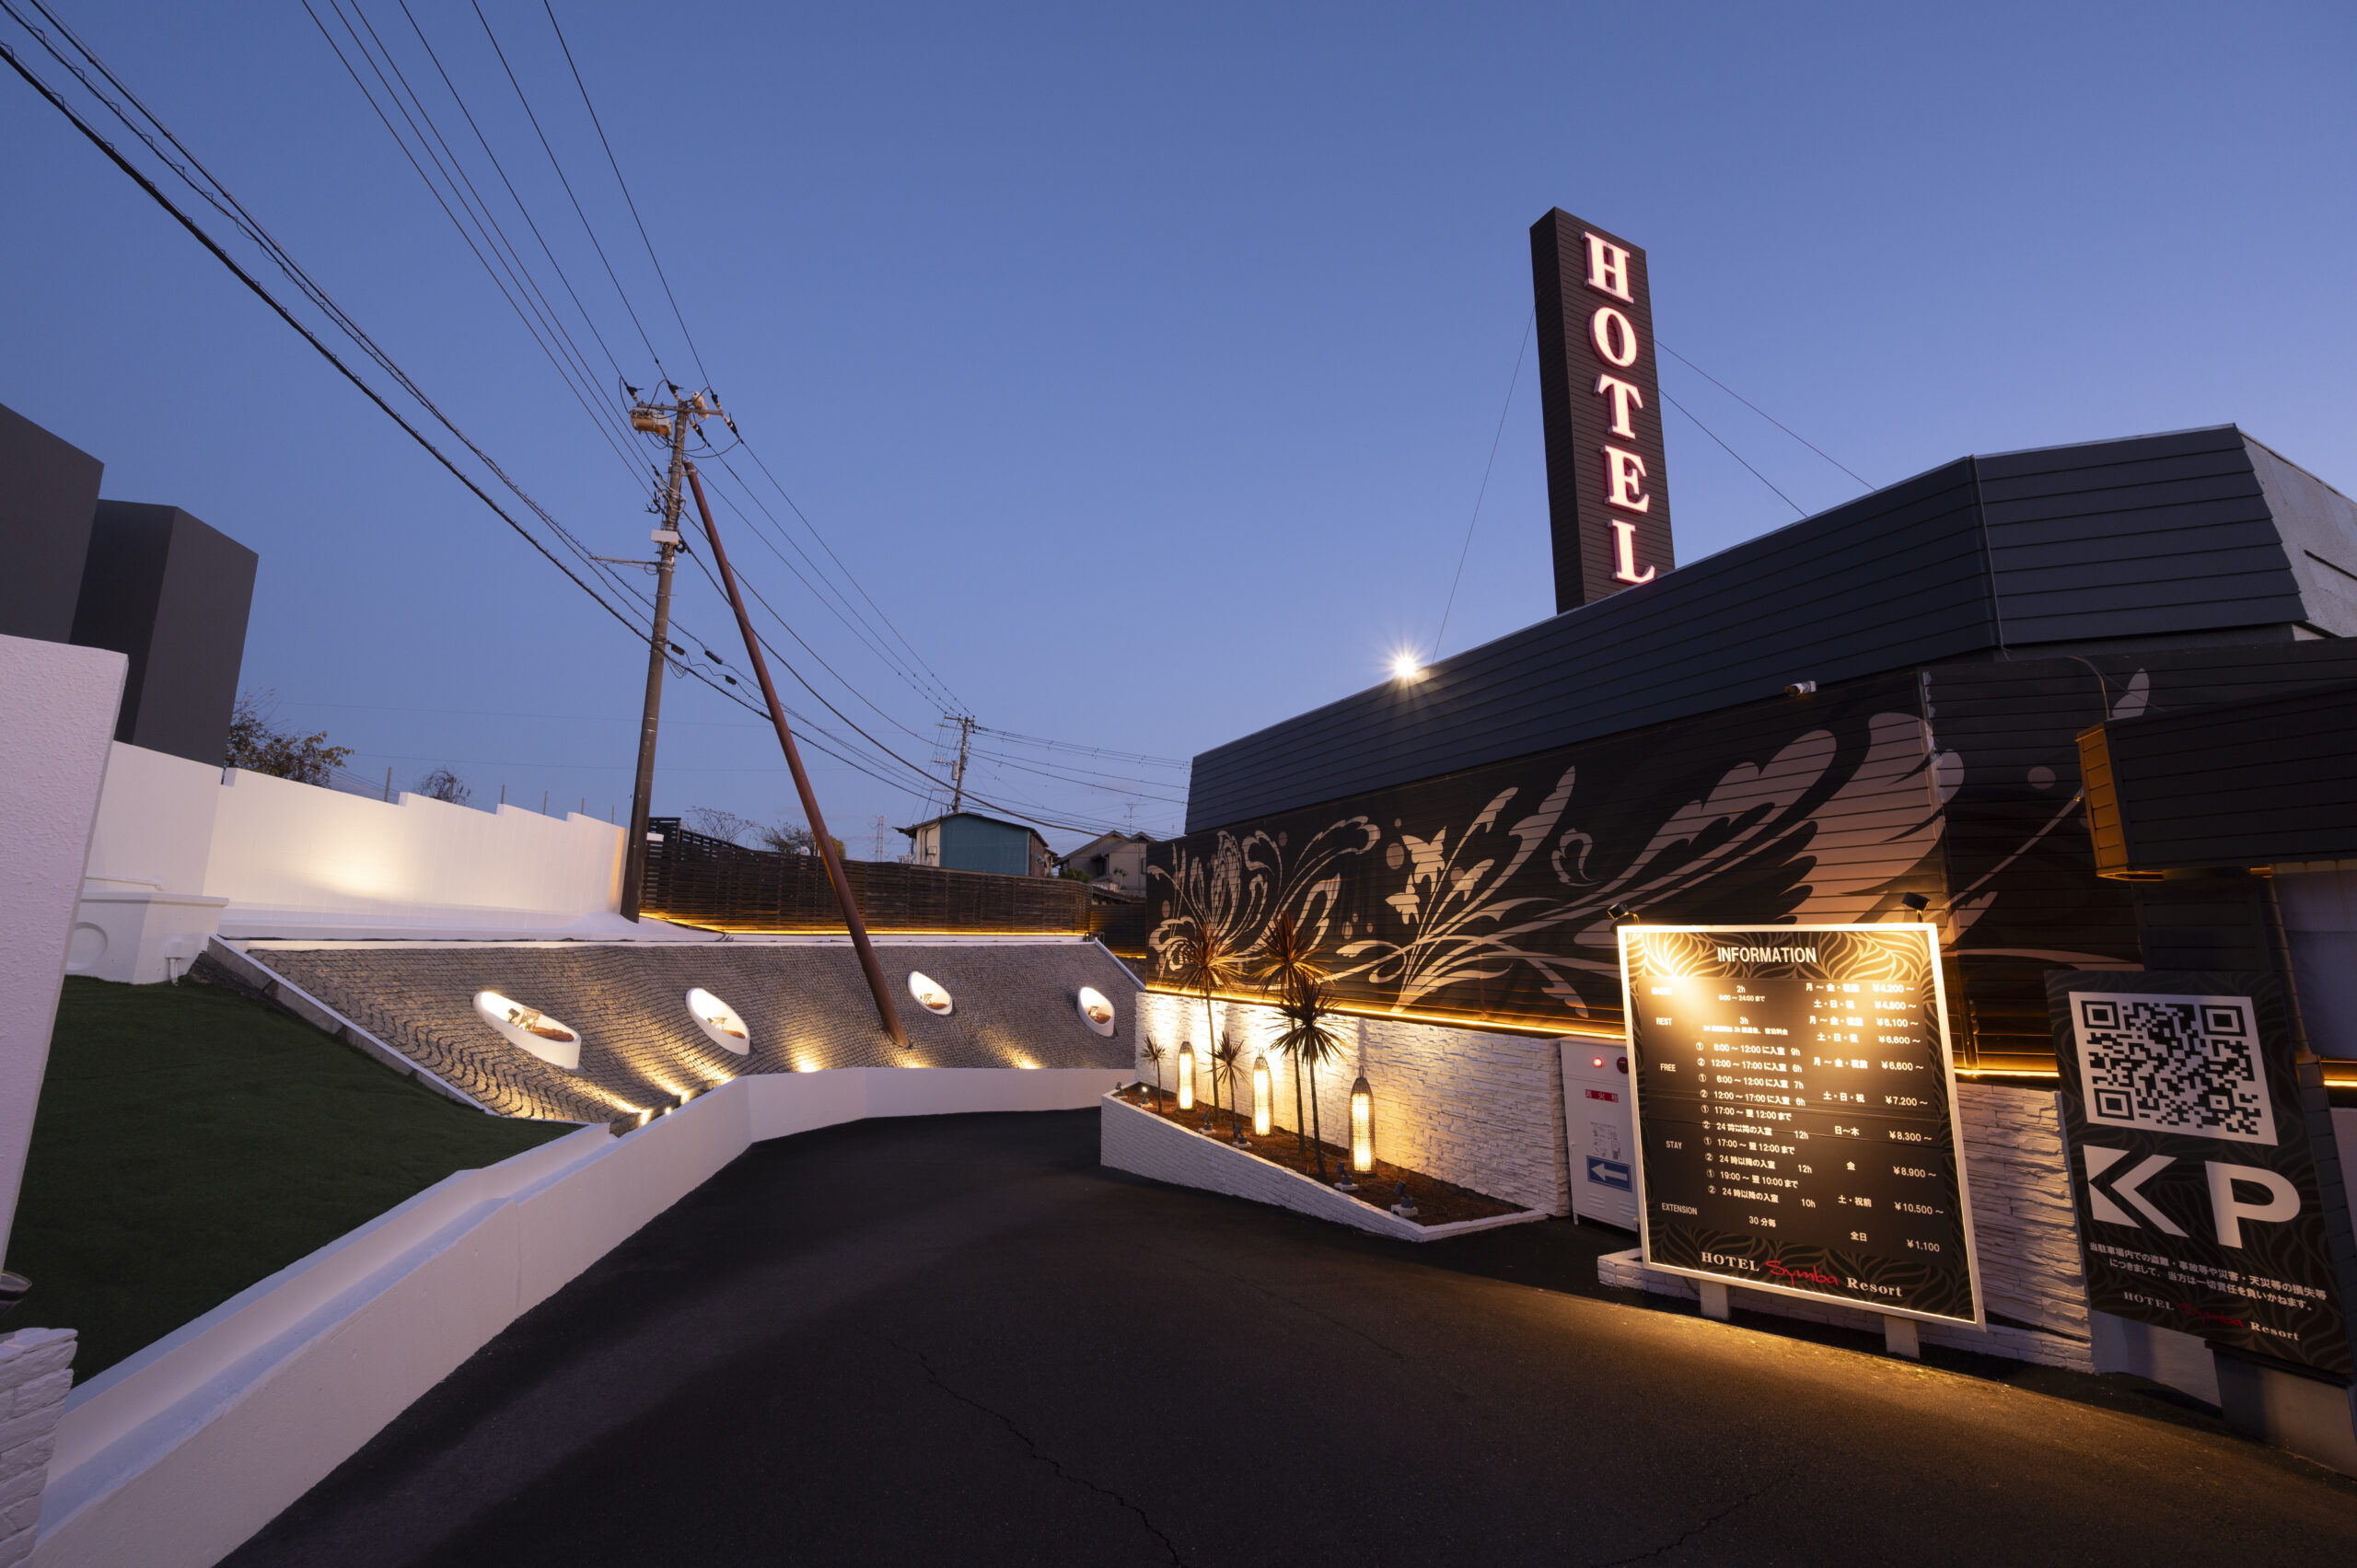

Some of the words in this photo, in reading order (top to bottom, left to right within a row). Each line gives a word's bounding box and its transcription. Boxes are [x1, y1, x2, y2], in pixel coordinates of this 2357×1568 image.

[1580, 231, 1655, 585] HOTEL
[1717, 947, 1817, 963] INFORMATION
[1736, 985, 1746, 993] 2h
[1656, 1017, 1672, 1026] REST
[1739, 1016, 1748, 1025] 3h
[1878, 1035, 1910, 1044] ¥6,600
[1713, 1043, 1730, 1052] 6:00
[1741, 1045, 1760, 1053] 12:00
[1791, 1048, 1801, 1056] 9h
[1660, 1063, 1676, 1072] FREE
[1712, 1059, 1731, 1067] 12:00
[1743, 1061, 1762, 1070] 17:00
[1793, 1064, 1802, 1073] 6h
[1881, 1061, 1913, 1071] ¥6,600
[1717, 1075, 1733, 1084] 6:00
[1744, 1077, 1764, 1086] 12:00
[1794, 1081, 1805, 1089] 7h
[1714, 1091, 1734, 1099] 12:00
[1746, 1094, 1765, 1102] 17:00
[1796, 1098, 1805, 1106] 6h
[1886, 1096, 1917, 1106] ¥7,200
[1715, 1107, 1735, 1115] 17:00
[1756, 1110, 1776, 1120] 12:00
[1778, 1112, 1792, 1121] まで
[1794, 1131, 1809, 1140] 12h
[1889, 1131, 1921, 1142] ¥8,300
[1666, 1141, 1683, 1150] STAY
[1717, 1139, 1737, 1147] 17:00
[1759, 1143, 1780, 1153] 12:00
[1782, 1145, 1794, 1155] まで
[1720, 1155, 1728, 1163] 24
[1798, 1165, 1812, 1174] 12h
[1893, 1166, 1925, 1178] ¥8,900
[1721, 1171, 1740, 1180] 19:00
[1762, 1177, 1782, 1186] 10:00
[1784, 1179, 1798, 1189] まで
[1723, 1188, 1732, 1196] 24
[1801, 1199, 1816, 1208] 10h
[1662, 1202, 1698, 1215] EXTENSION
[1895, 1202, 1933, 1214] ¥10,500
[1749, 1216, 1759, 1225] 30
[1906, 1239, 1940, 1252] ¥1,100
[1701, 1252, 1759, 1272] HOTEL
[1766, 1260, 1840, 1285] Symba
[1846, 1277, 1903, 1296] Resort
[2123, 1291, 2175, 1311] HOTEL
[2250, 1321, 2300, 1341] Resort
